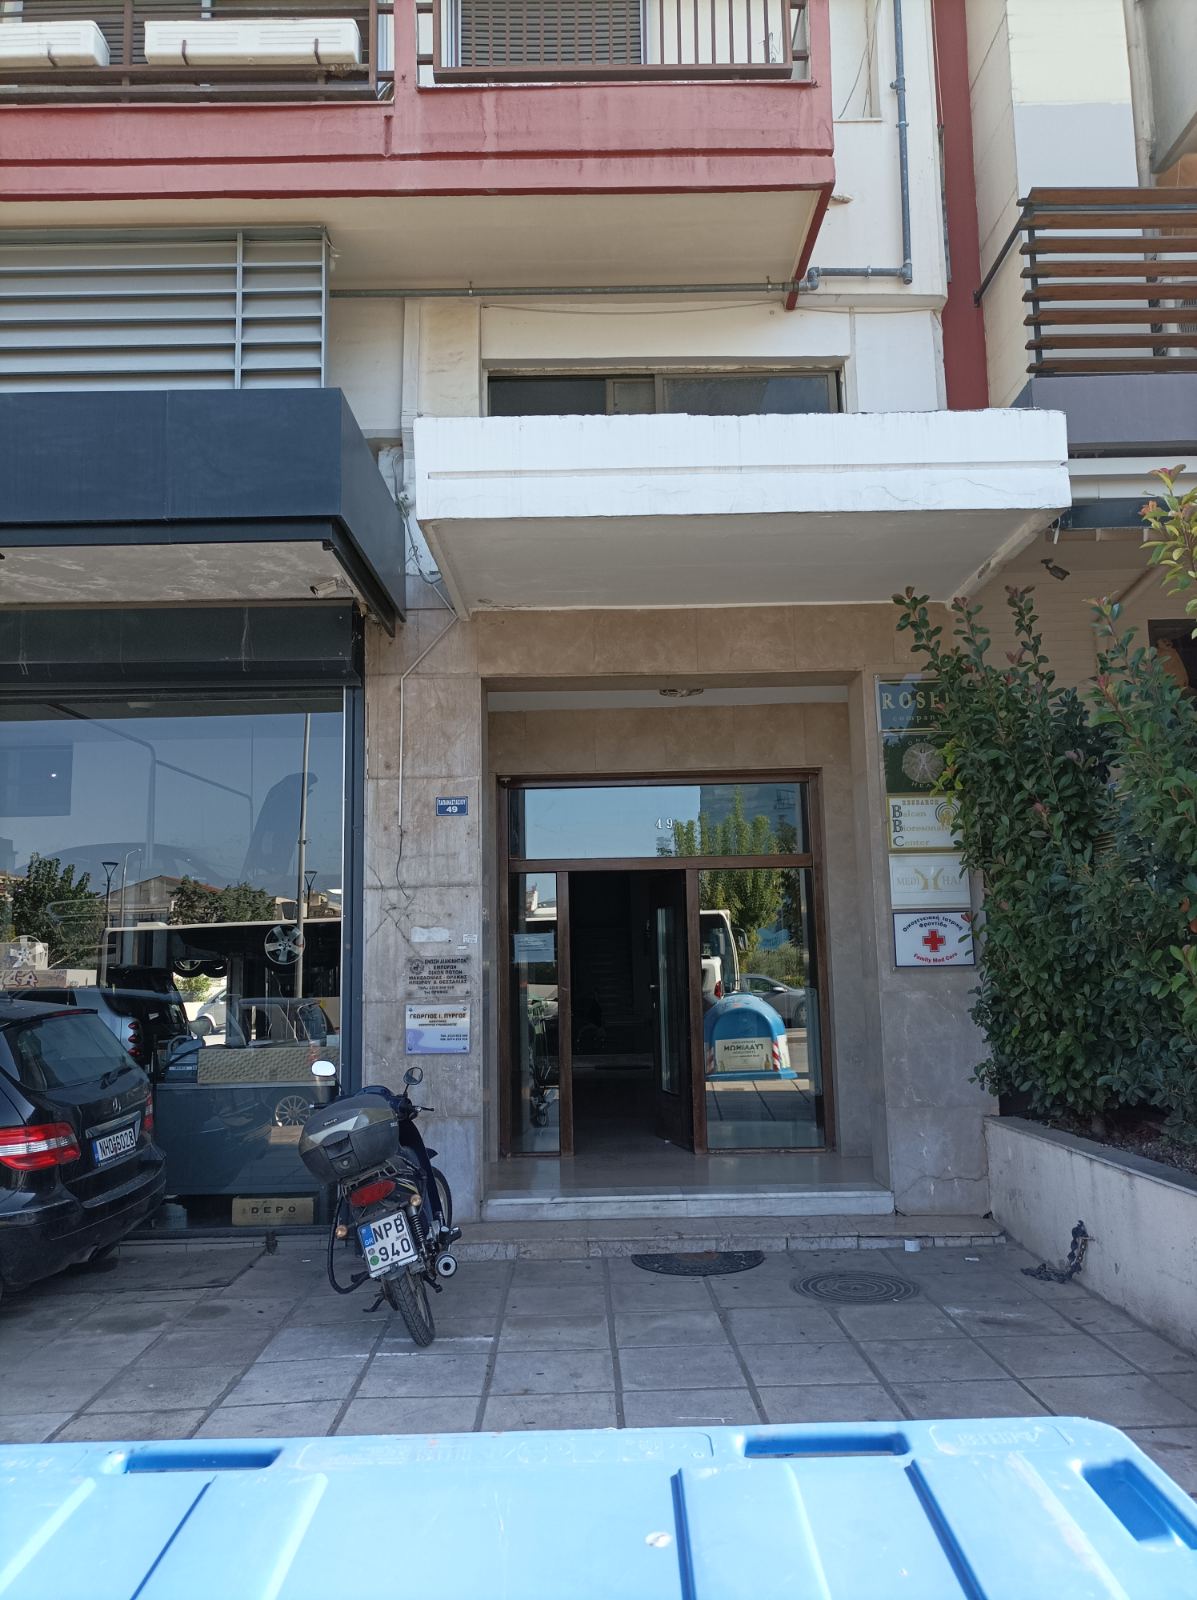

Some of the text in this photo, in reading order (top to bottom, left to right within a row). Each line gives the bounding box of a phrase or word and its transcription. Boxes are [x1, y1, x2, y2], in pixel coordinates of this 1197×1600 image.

[446, 805, 458, 813] 49
[655, 817, 673, 829] 49
[913, 952, 931, 963] Family
[945, 952, 958, 960] Care
[251, 1206, 296, 1214] DEPO
[378, 1237, 412, 1262] 940
